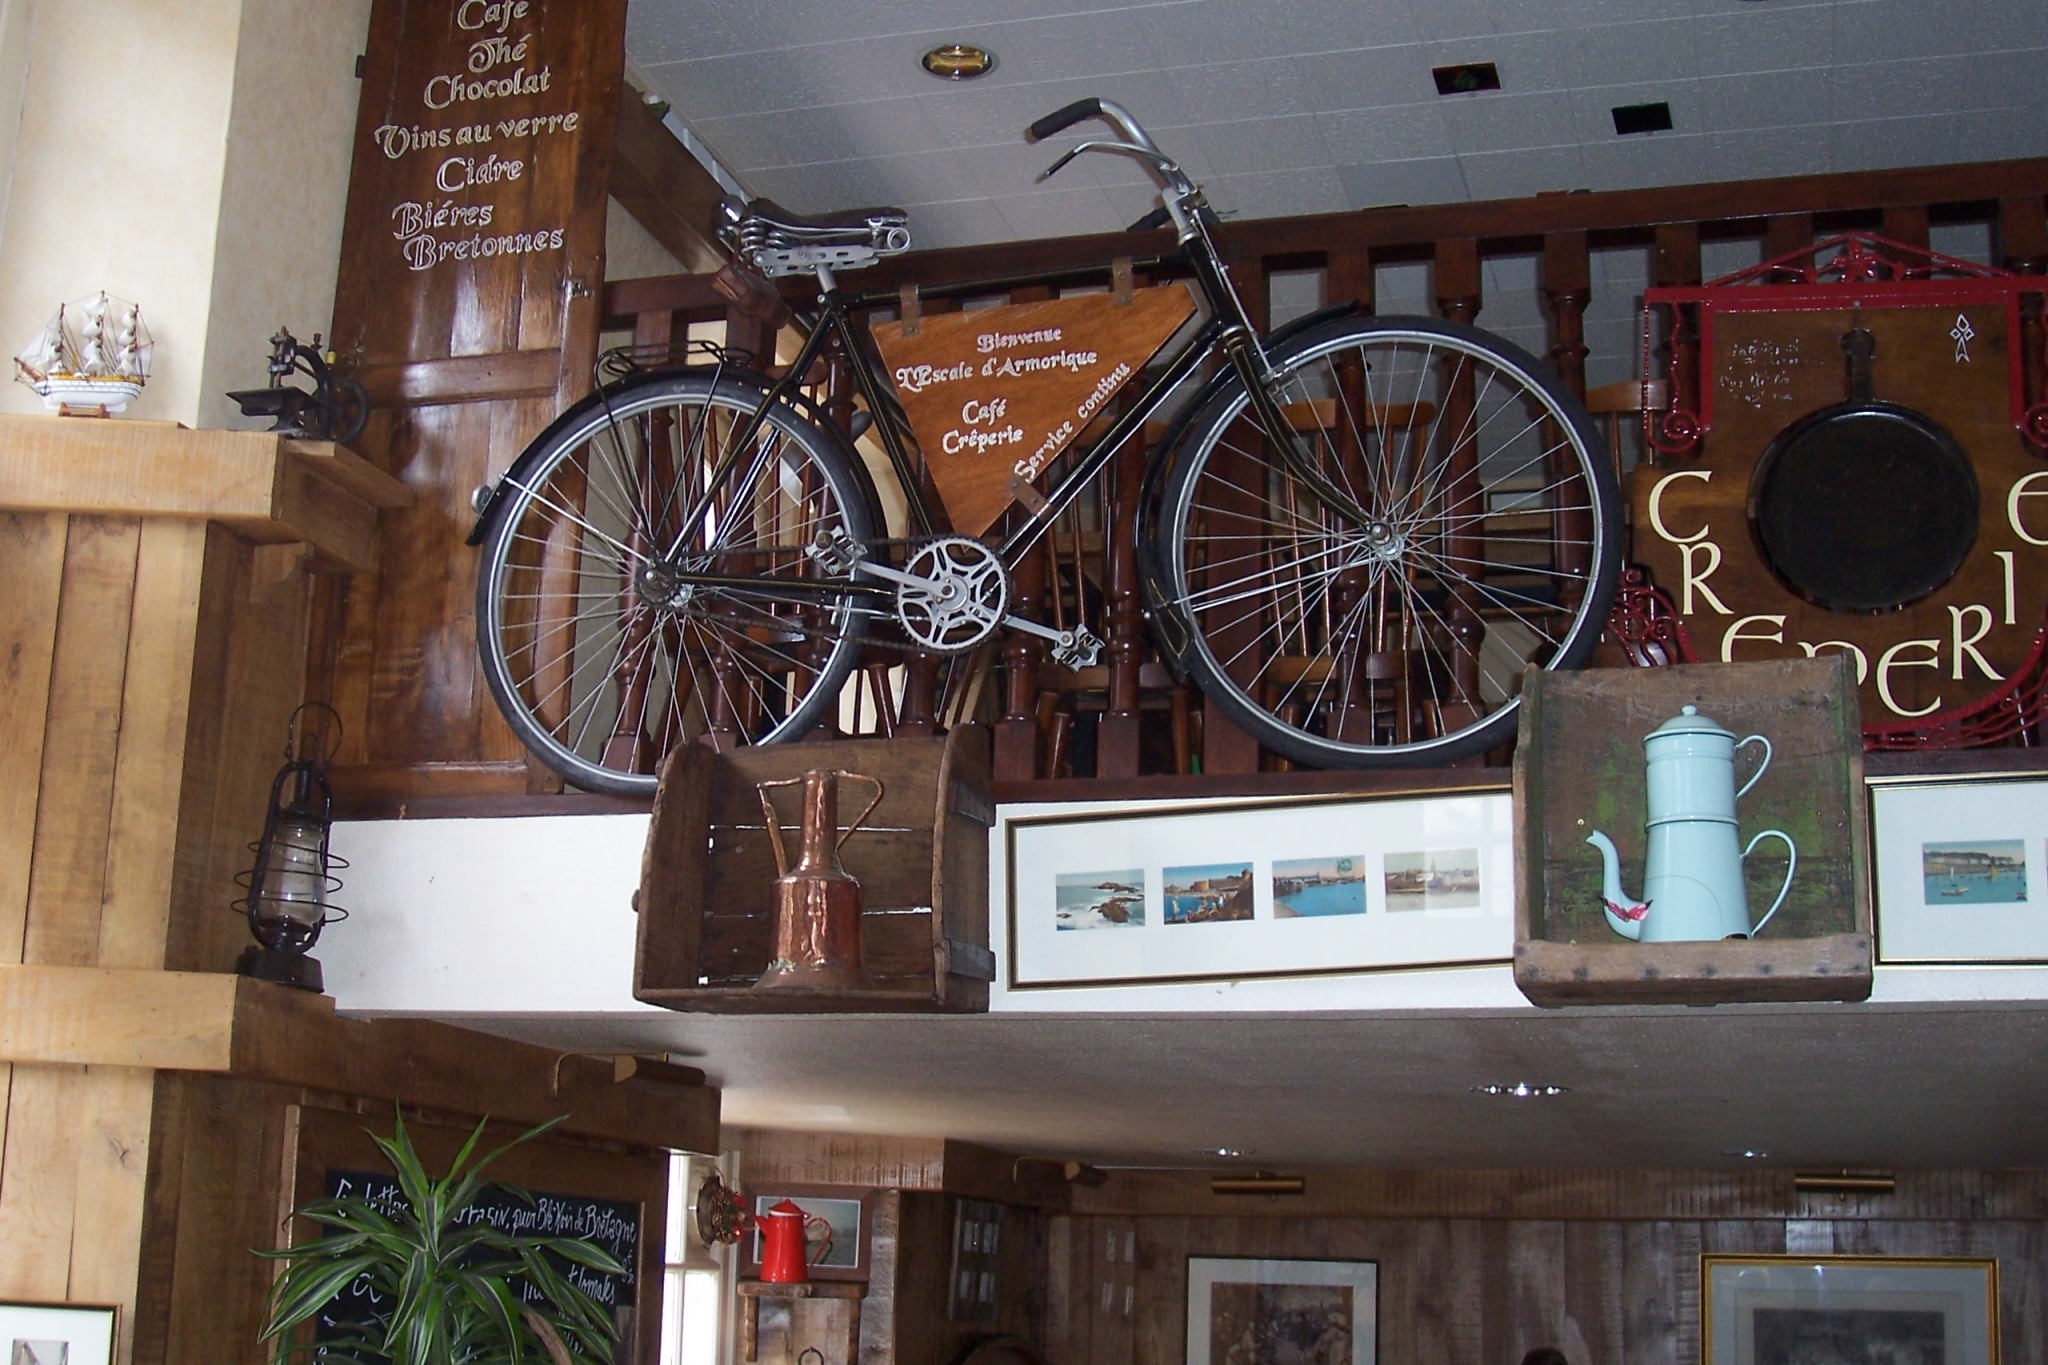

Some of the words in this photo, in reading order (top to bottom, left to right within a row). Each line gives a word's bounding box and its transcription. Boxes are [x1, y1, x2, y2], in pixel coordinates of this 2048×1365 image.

[468, 33, 532, 73] Thé
[424, 66, 551, 109] Chocolat
[374, 125, 451, 159] Vins
[456, 123, 492, 145] au
[495, 111, 579, 138] verre
[436, 154, 524, 192] Cidre
[403, 228, 564, 271] Bretonnes
[977, 328, 1062, 353] Bienvenue
[981, 350, 1097, 377] d'Armorique
[962, 398, 1007, 426] Café
[1014, 419, 1074, 483] Service
[1077, 361, 1131, 420] continu
[942, 424, 1024, 454] Crêperie
